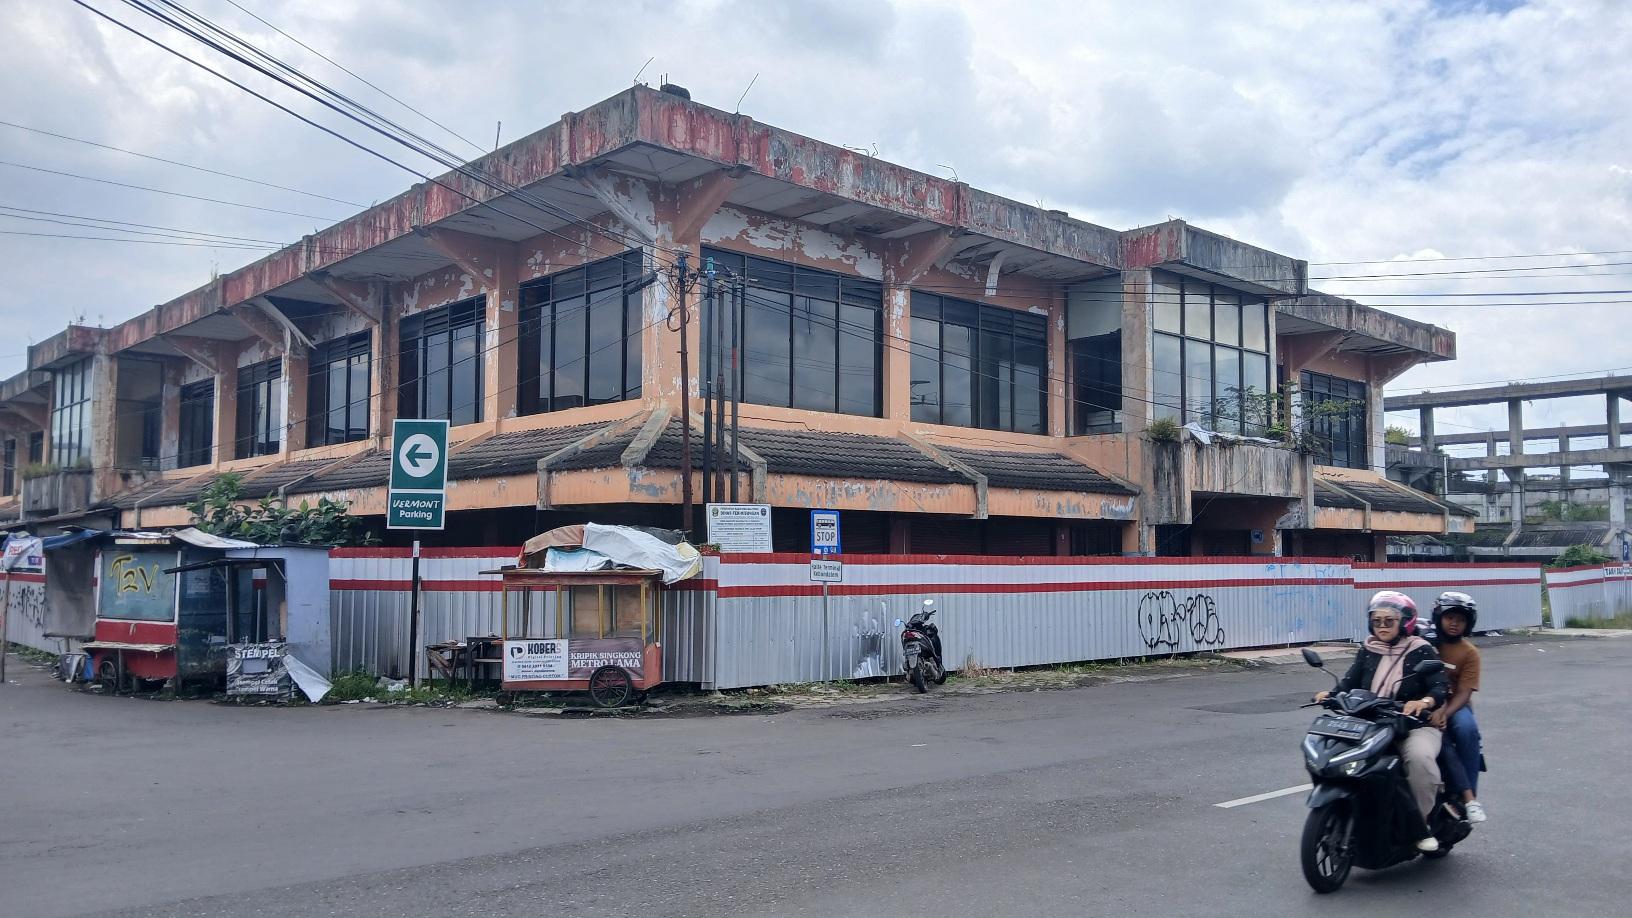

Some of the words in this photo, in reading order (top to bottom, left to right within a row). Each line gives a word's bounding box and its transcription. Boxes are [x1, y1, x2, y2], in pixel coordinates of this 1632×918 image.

[392, 499, 441, 509] VERMONT
[399, 510, 433, 521] Parking
[816, 531, 836, 542] STOP
[235, 649, 280, 659] STEMPEL
[570, 652, 598, 660] KRIPIK
[599, 651, 641, 659] SINGKONG
[571, 659, 608, 668] METRO
[608, 658, 641, 668] LAMA
